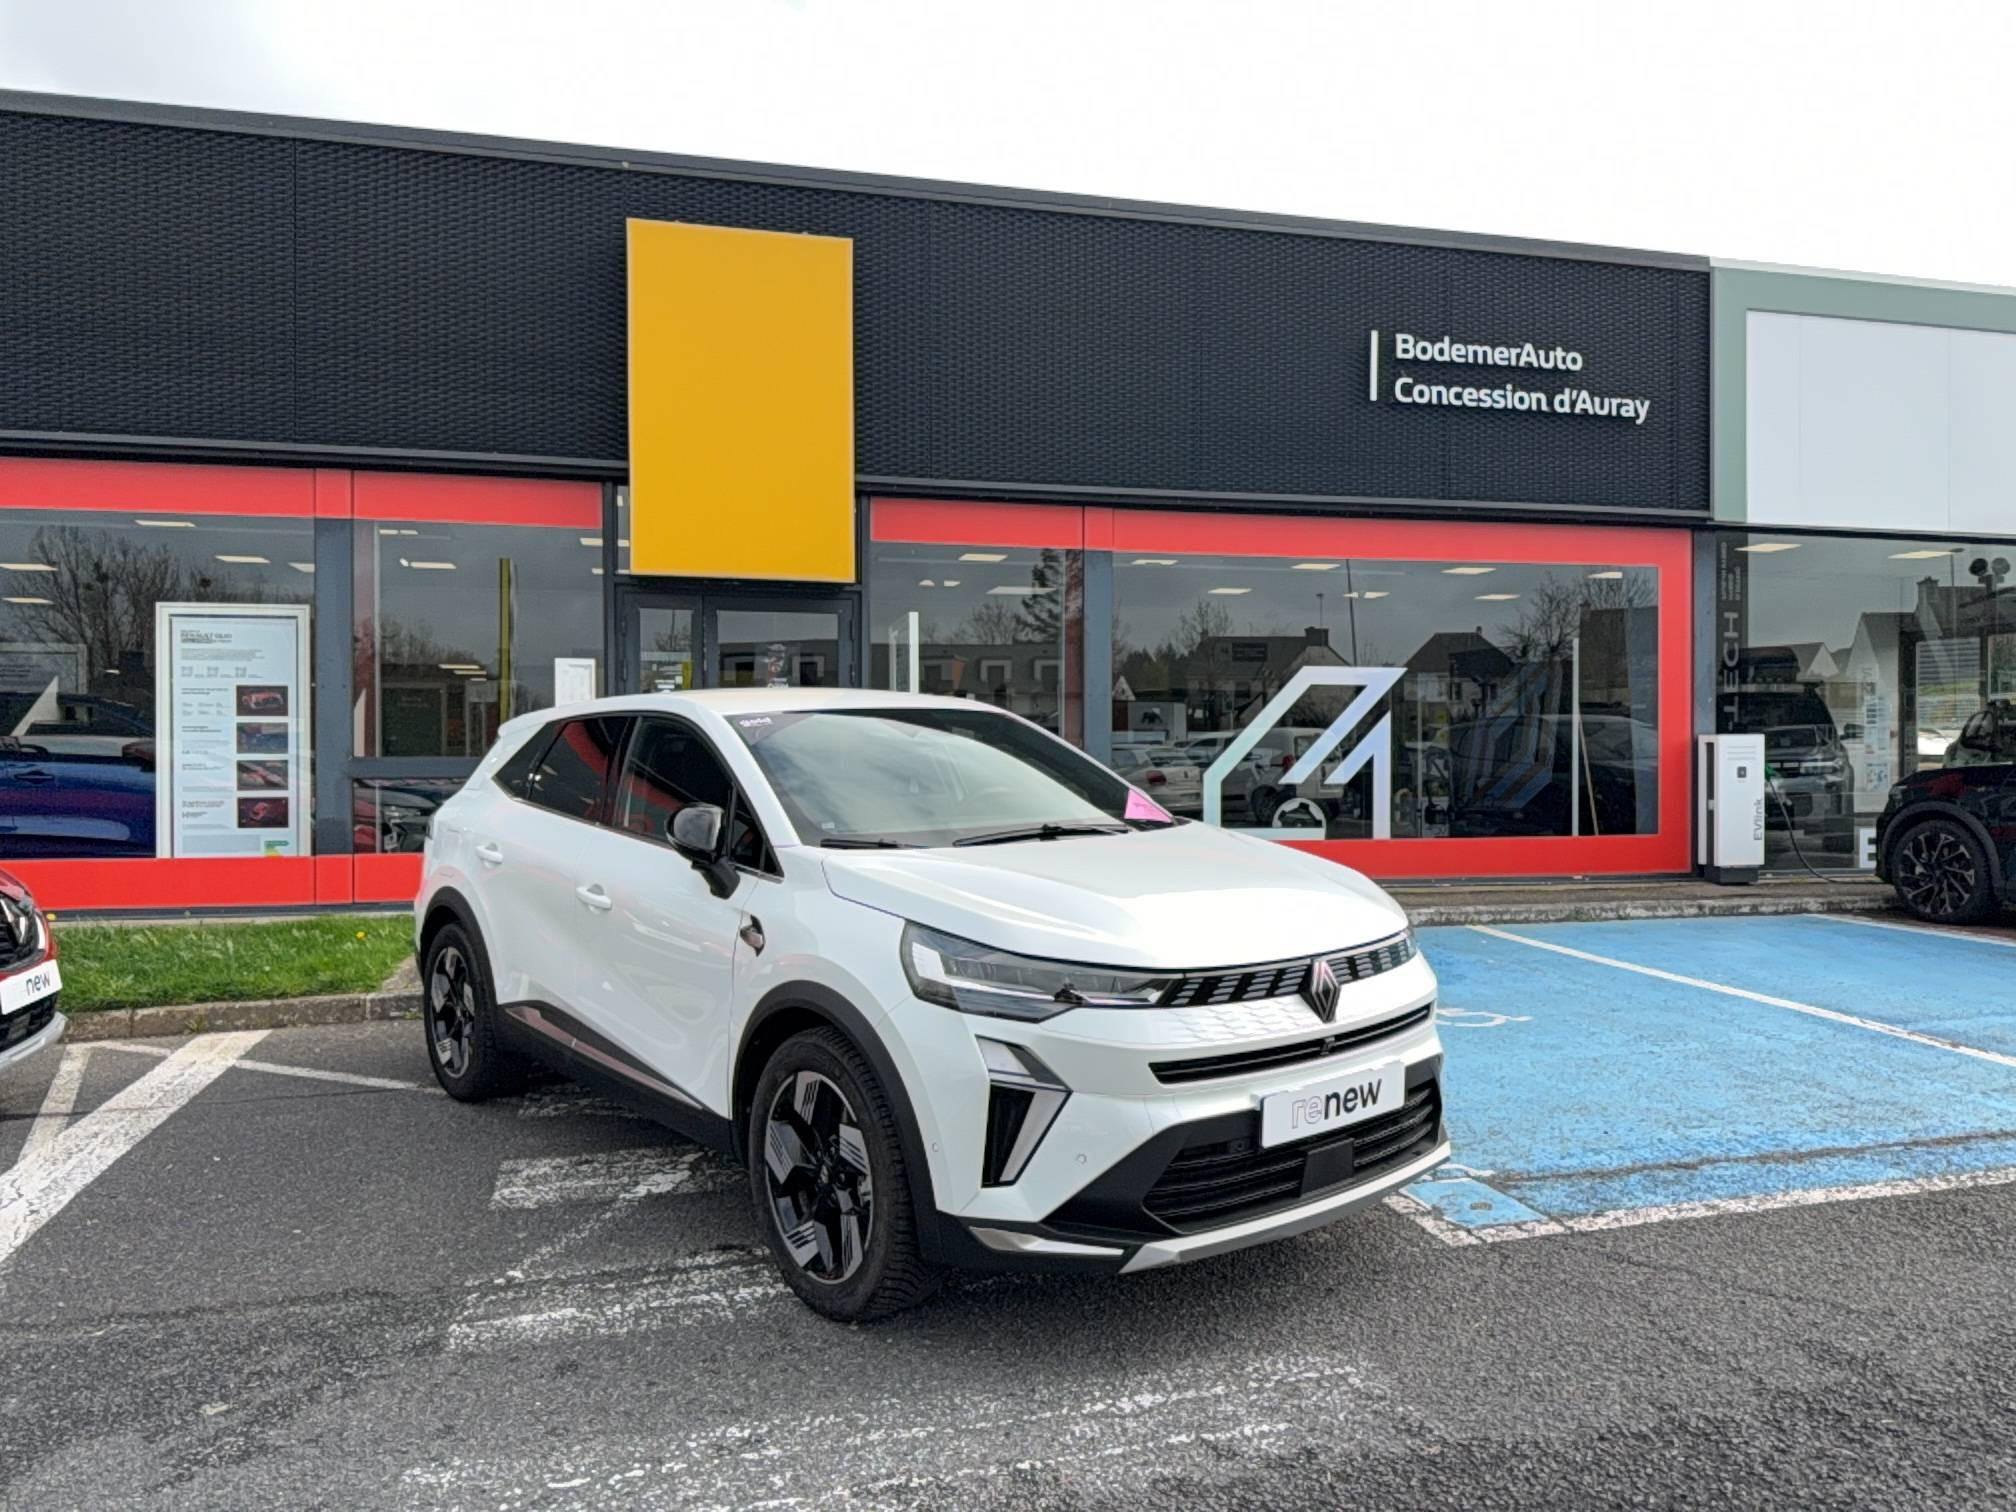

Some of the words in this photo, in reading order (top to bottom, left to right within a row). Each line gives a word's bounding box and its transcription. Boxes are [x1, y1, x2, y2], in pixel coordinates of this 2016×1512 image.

[1395, 333, 1583, 371] BodemerAuto
[1394, 377, 1549, 412] Concession
[1554, 387, 1650, 425] d'Auray
[1291, 1078, 1382, 1130] renew
